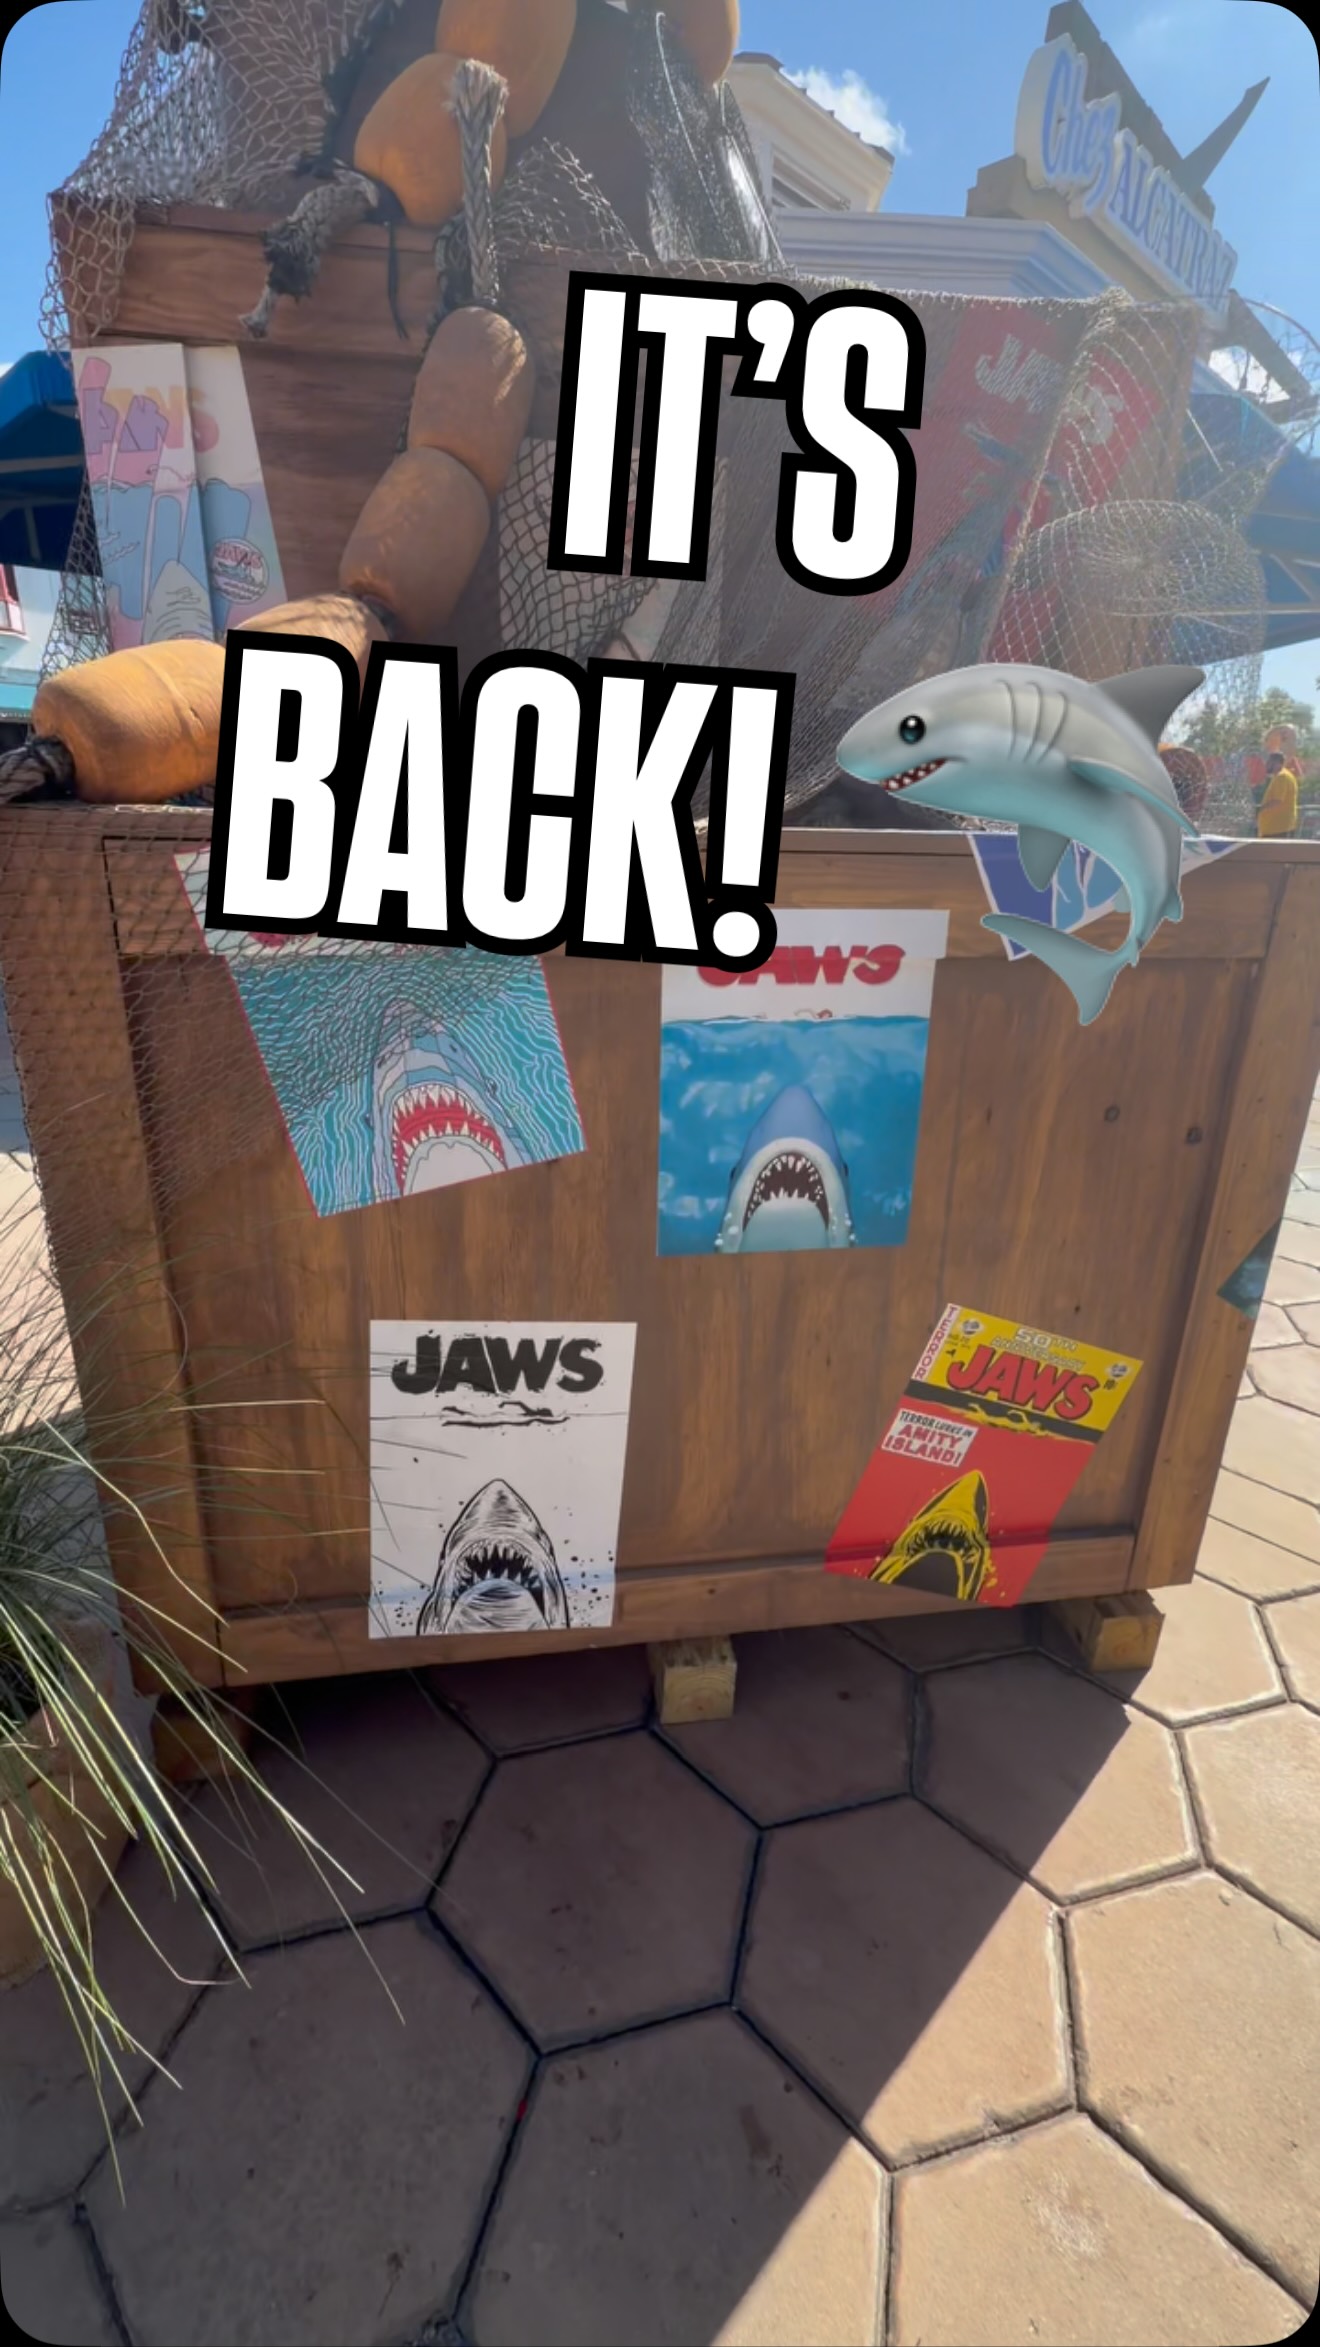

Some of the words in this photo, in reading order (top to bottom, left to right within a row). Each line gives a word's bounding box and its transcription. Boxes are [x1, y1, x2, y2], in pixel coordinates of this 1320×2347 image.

[1041, 48, 1120, 208] Chez
[1108, 141, 1234, 313] ALCATRAZ
[391, 1334, 604, 1395] JAWS
[914, 1306, 958, 1380] TERROR
[946, 1344, 1100, 1421] JAWS
[885, 1434, 962, 1465] ISLAND!
[898, 1423, 962, 1449] AMITY
[899, 1410, 935, 1428] TERROR
